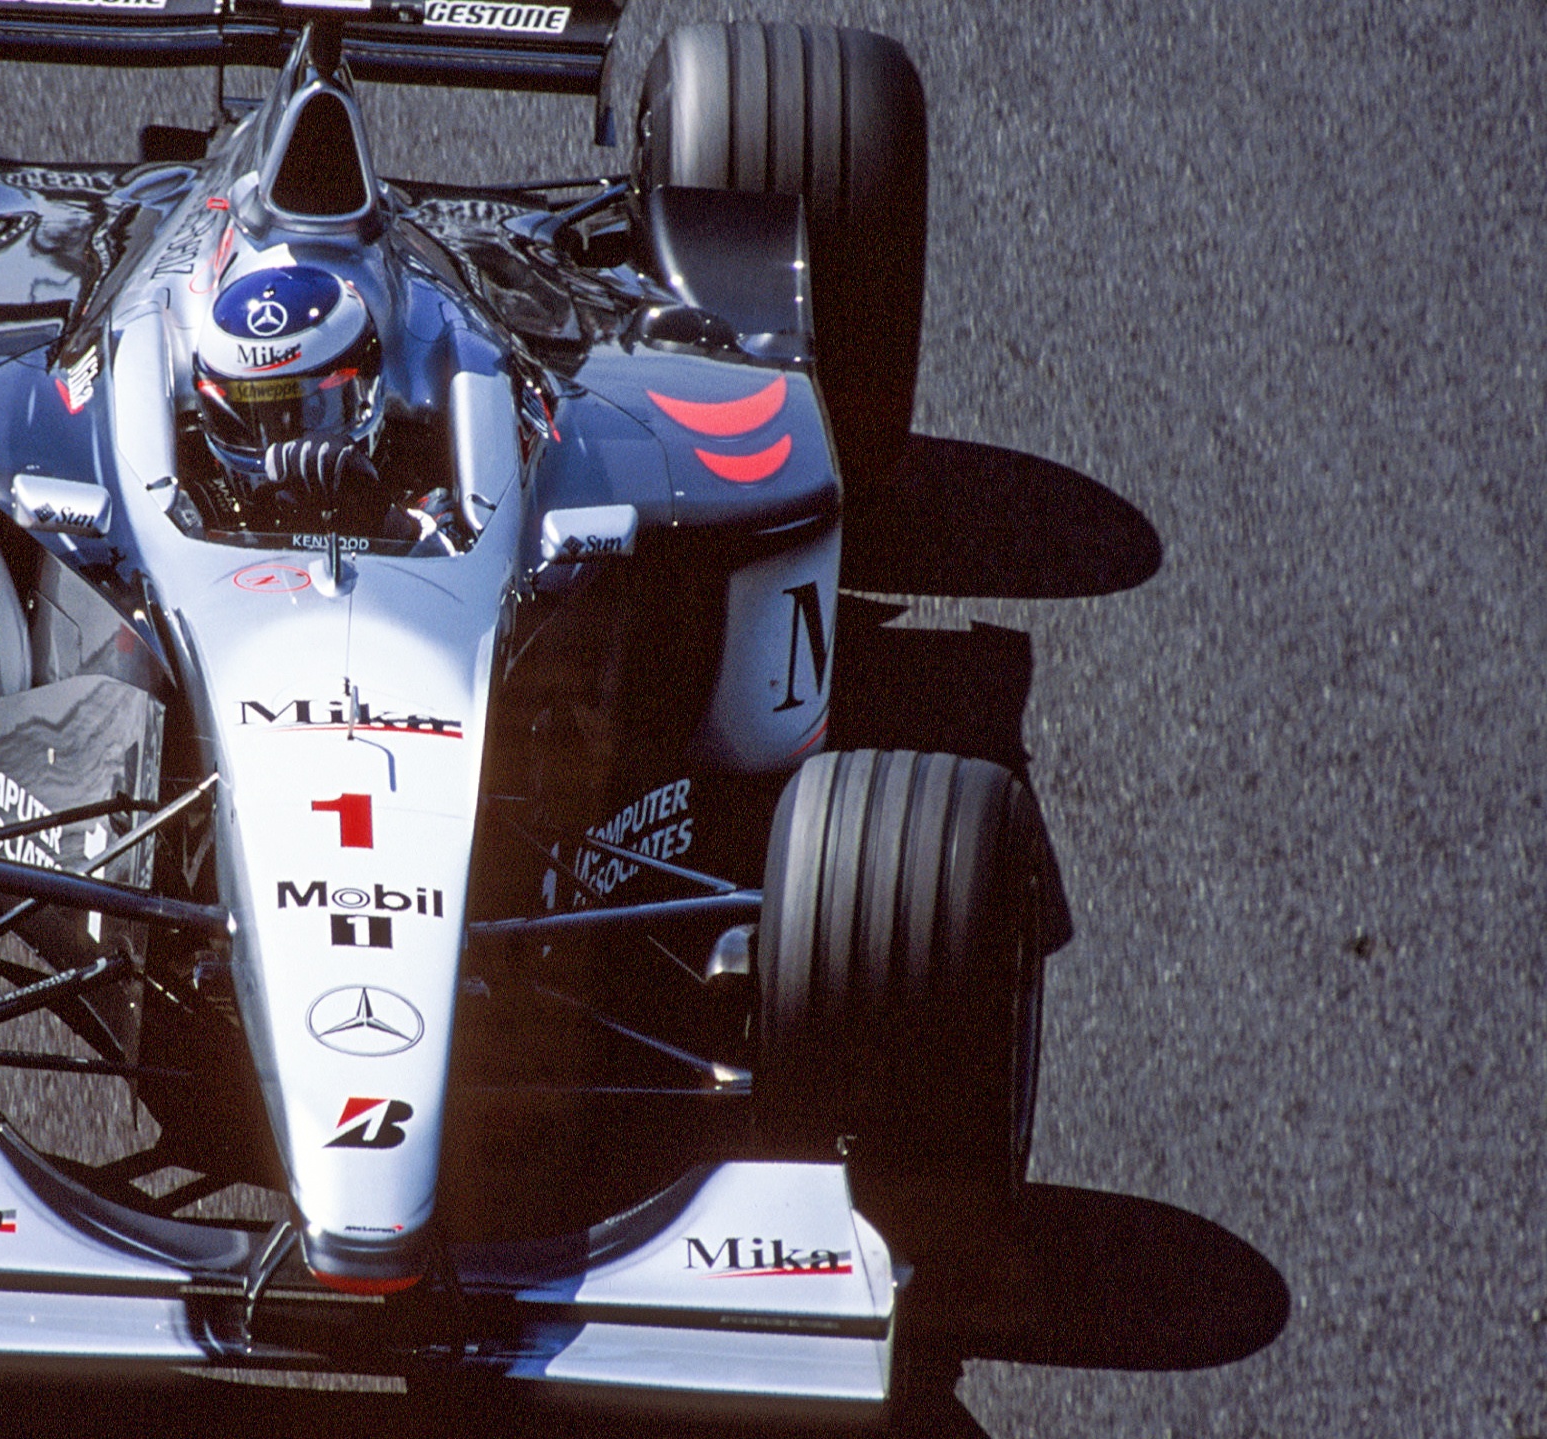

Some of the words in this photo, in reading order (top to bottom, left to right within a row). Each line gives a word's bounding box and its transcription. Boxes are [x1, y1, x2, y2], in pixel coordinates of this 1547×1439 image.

[237, 343, 301, 367] Mika
[56, 506, 95, 528] Sun
[585, 534, 622, 552] Sun
[235, 700, 446, 734] Mika
[311, 792, 374, 849] 1
[277, 881, 444, 918] Mobil
[683, 1237, 841, 1271] Mika
